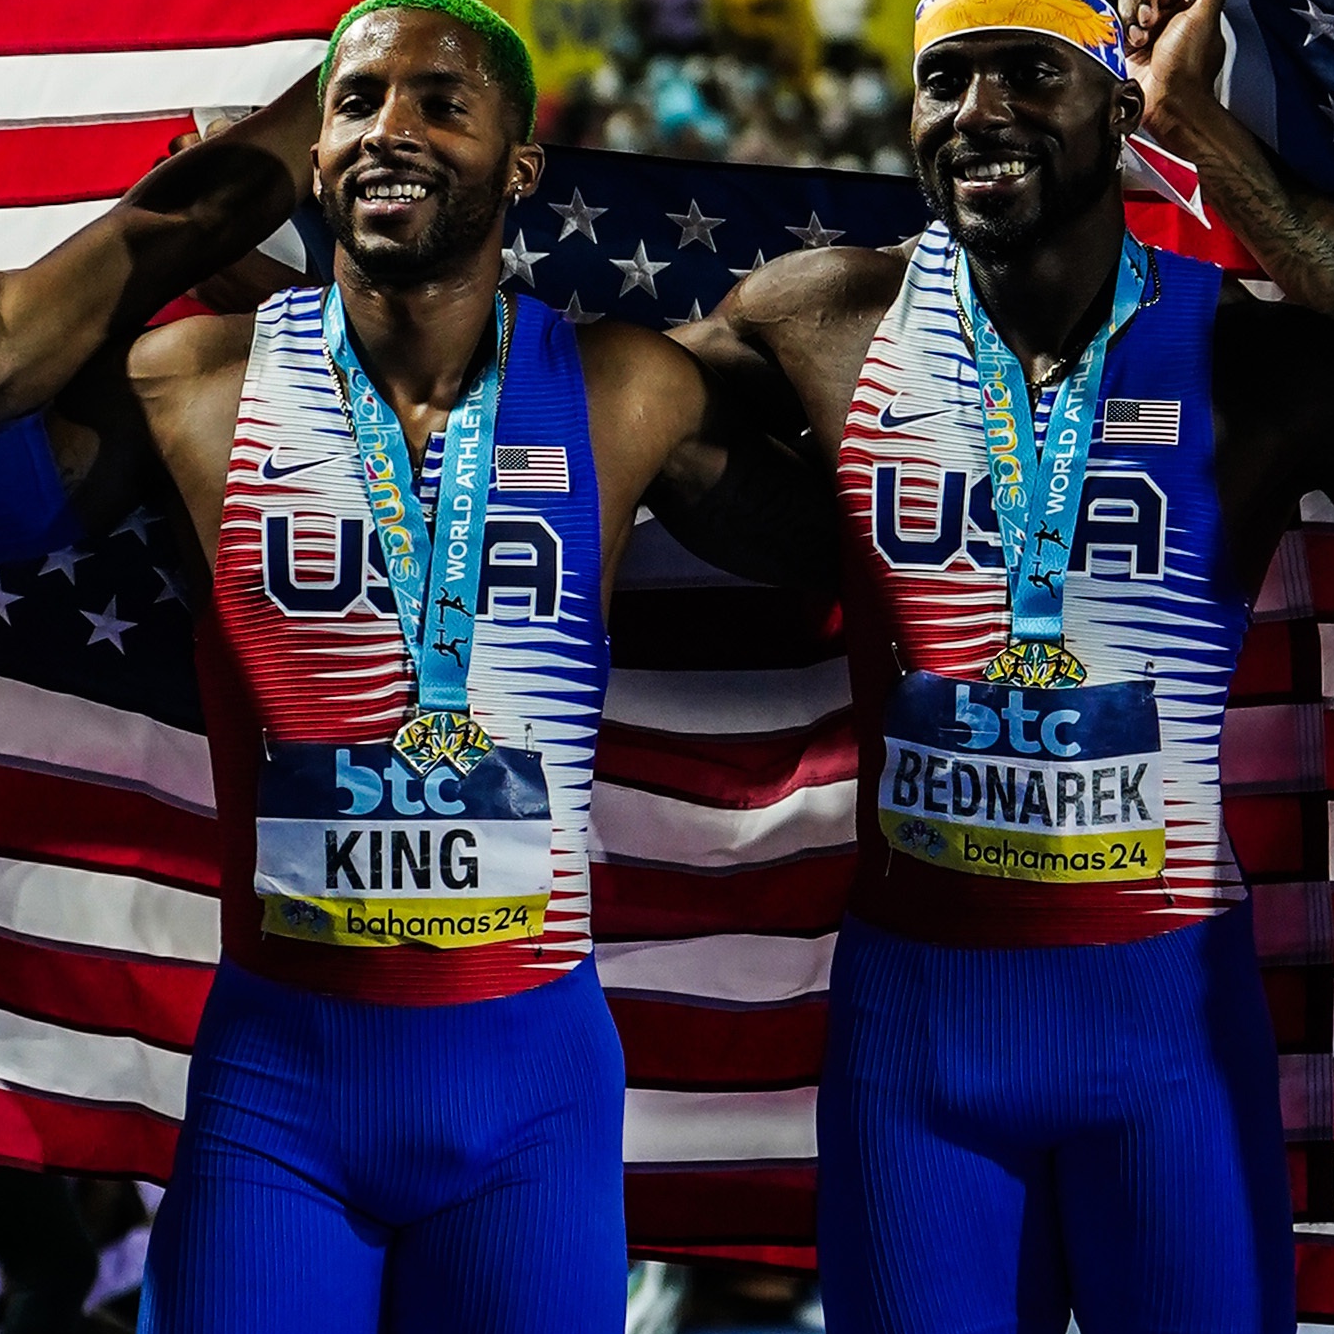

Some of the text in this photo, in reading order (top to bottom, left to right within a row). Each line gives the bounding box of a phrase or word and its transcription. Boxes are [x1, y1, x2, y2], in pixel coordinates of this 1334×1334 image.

[1046, 338, 1096, 517] WORLD ATHLE
[445, 377, 485, 583] WORLD ATHLETIC
[955, 684, 1081, 757] btc
[335, 748, 466, 816] btc
[892, 748, 1152, 828] BEDNAREK
[324, 828, 479, 890] KING
[963, 833, 1148, 872] bahamas24
[346, 905, 529, 936] bahamas24
